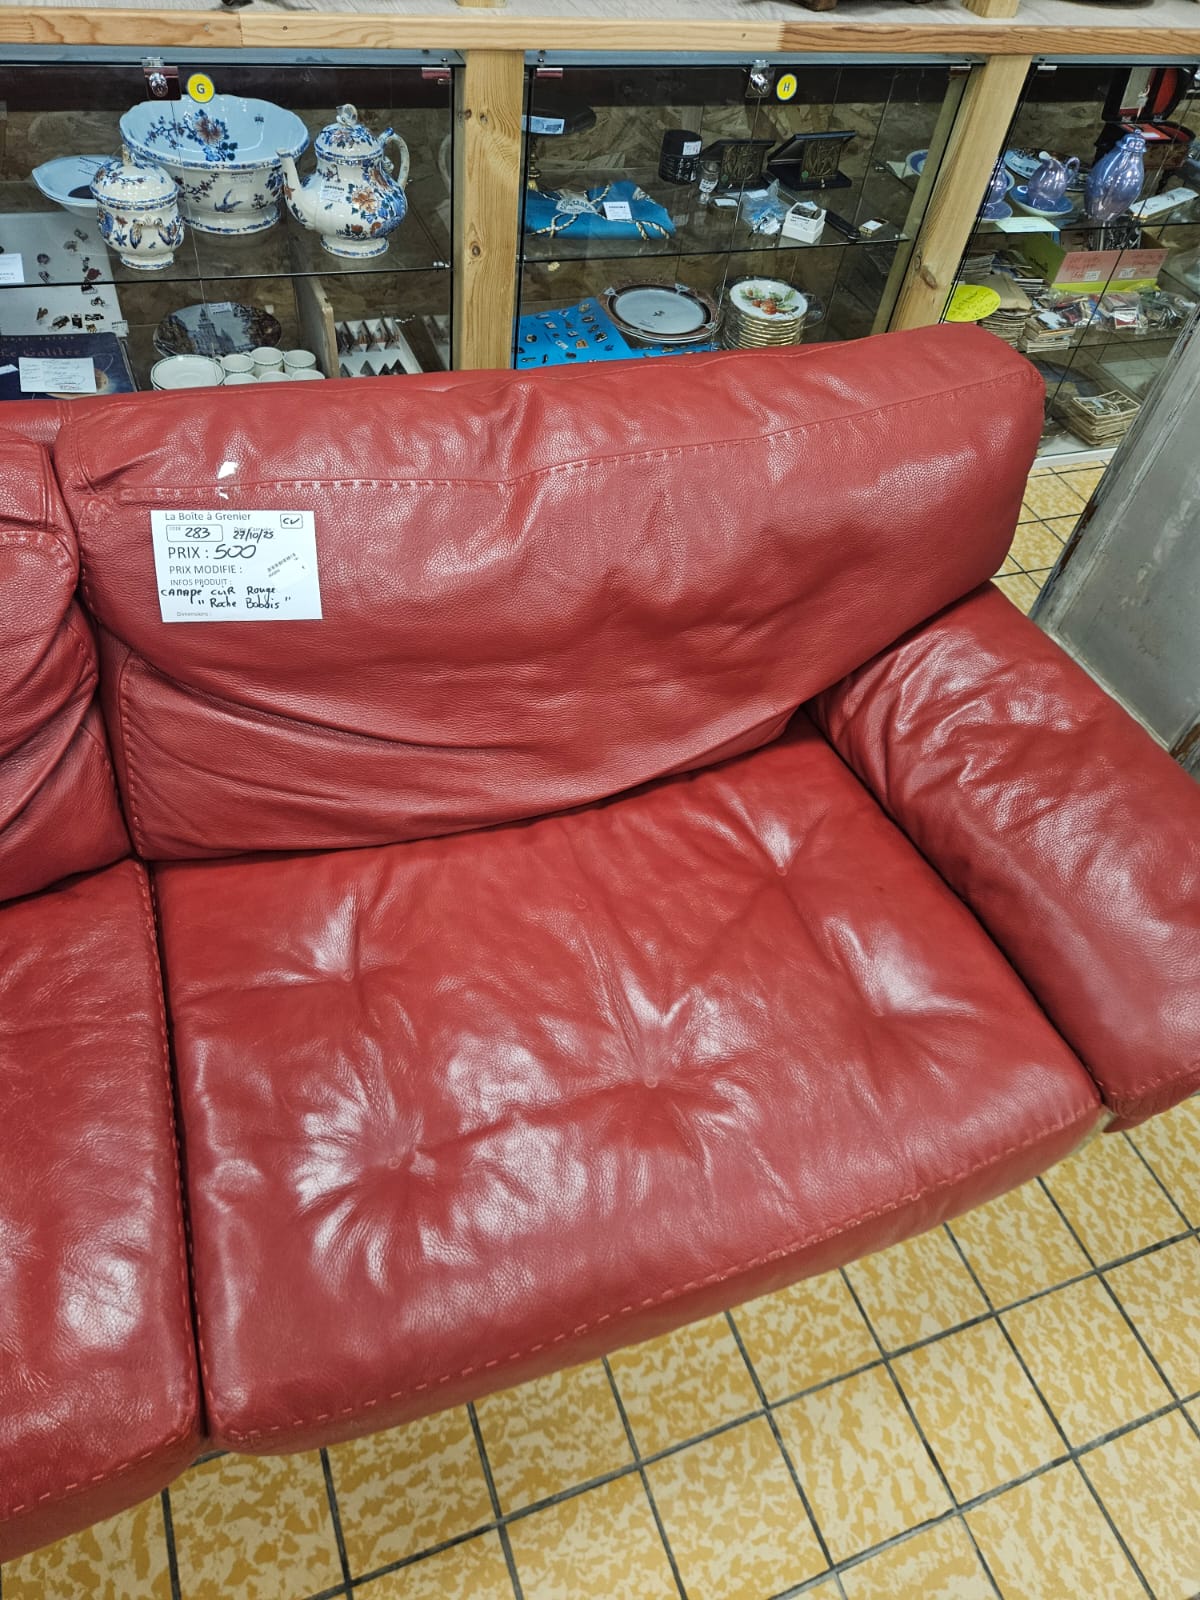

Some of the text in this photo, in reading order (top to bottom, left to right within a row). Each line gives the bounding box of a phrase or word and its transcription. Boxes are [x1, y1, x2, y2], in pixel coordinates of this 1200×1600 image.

[196, 83, 205, 94] G
[783, 82, 791, 92] H
[165, 511, 251, 520] La Boîte à Grenier
[185, 527, 211, 539] 283
[168, 546, 201, 559] PRIX
[213, 544, 257, 559] 500
[169, 565, 192, 574] PRIX
[194, 564, 237, 575] MODIFIE
[194, 578, 227, 586] PRODUIT
